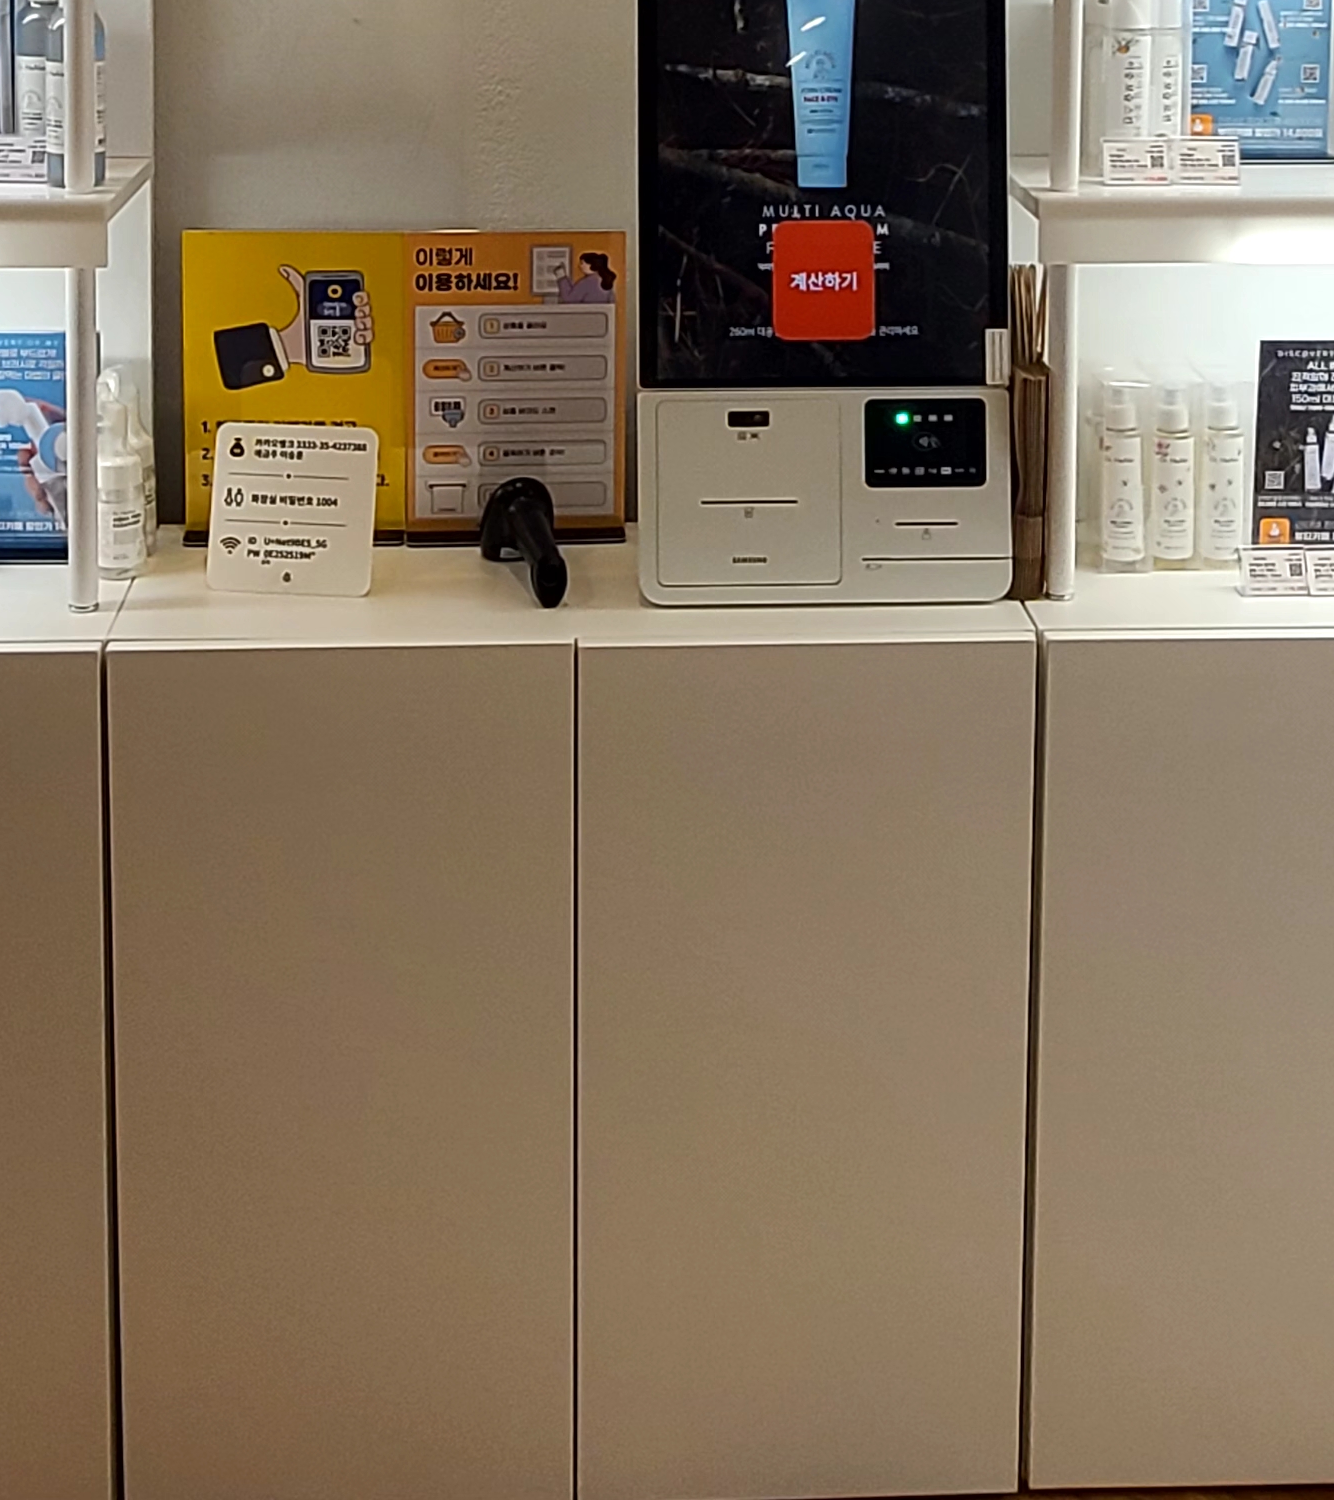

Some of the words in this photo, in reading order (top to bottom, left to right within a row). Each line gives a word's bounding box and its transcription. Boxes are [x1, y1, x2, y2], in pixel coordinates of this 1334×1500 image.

[762, 205, 820, 218] MULTI
[831, 204, 886, 219] AQUA
[416, 248, 473, 267] 이렇게
[416, 273, 519, 292] 이용하세요!
[790, 272, 858, 292] 계산하기
[1307, 361, 1329, 370] ALL
[201, 421, 211, 434] 1.
[201, 448, 213, 460] 2.
[201, 474, 213, 487] 3.
[251, 494, 277, 504] 화장실
[279, 495, 313, 506] 비밀번호
[316, 497, 338, 507] 1004
